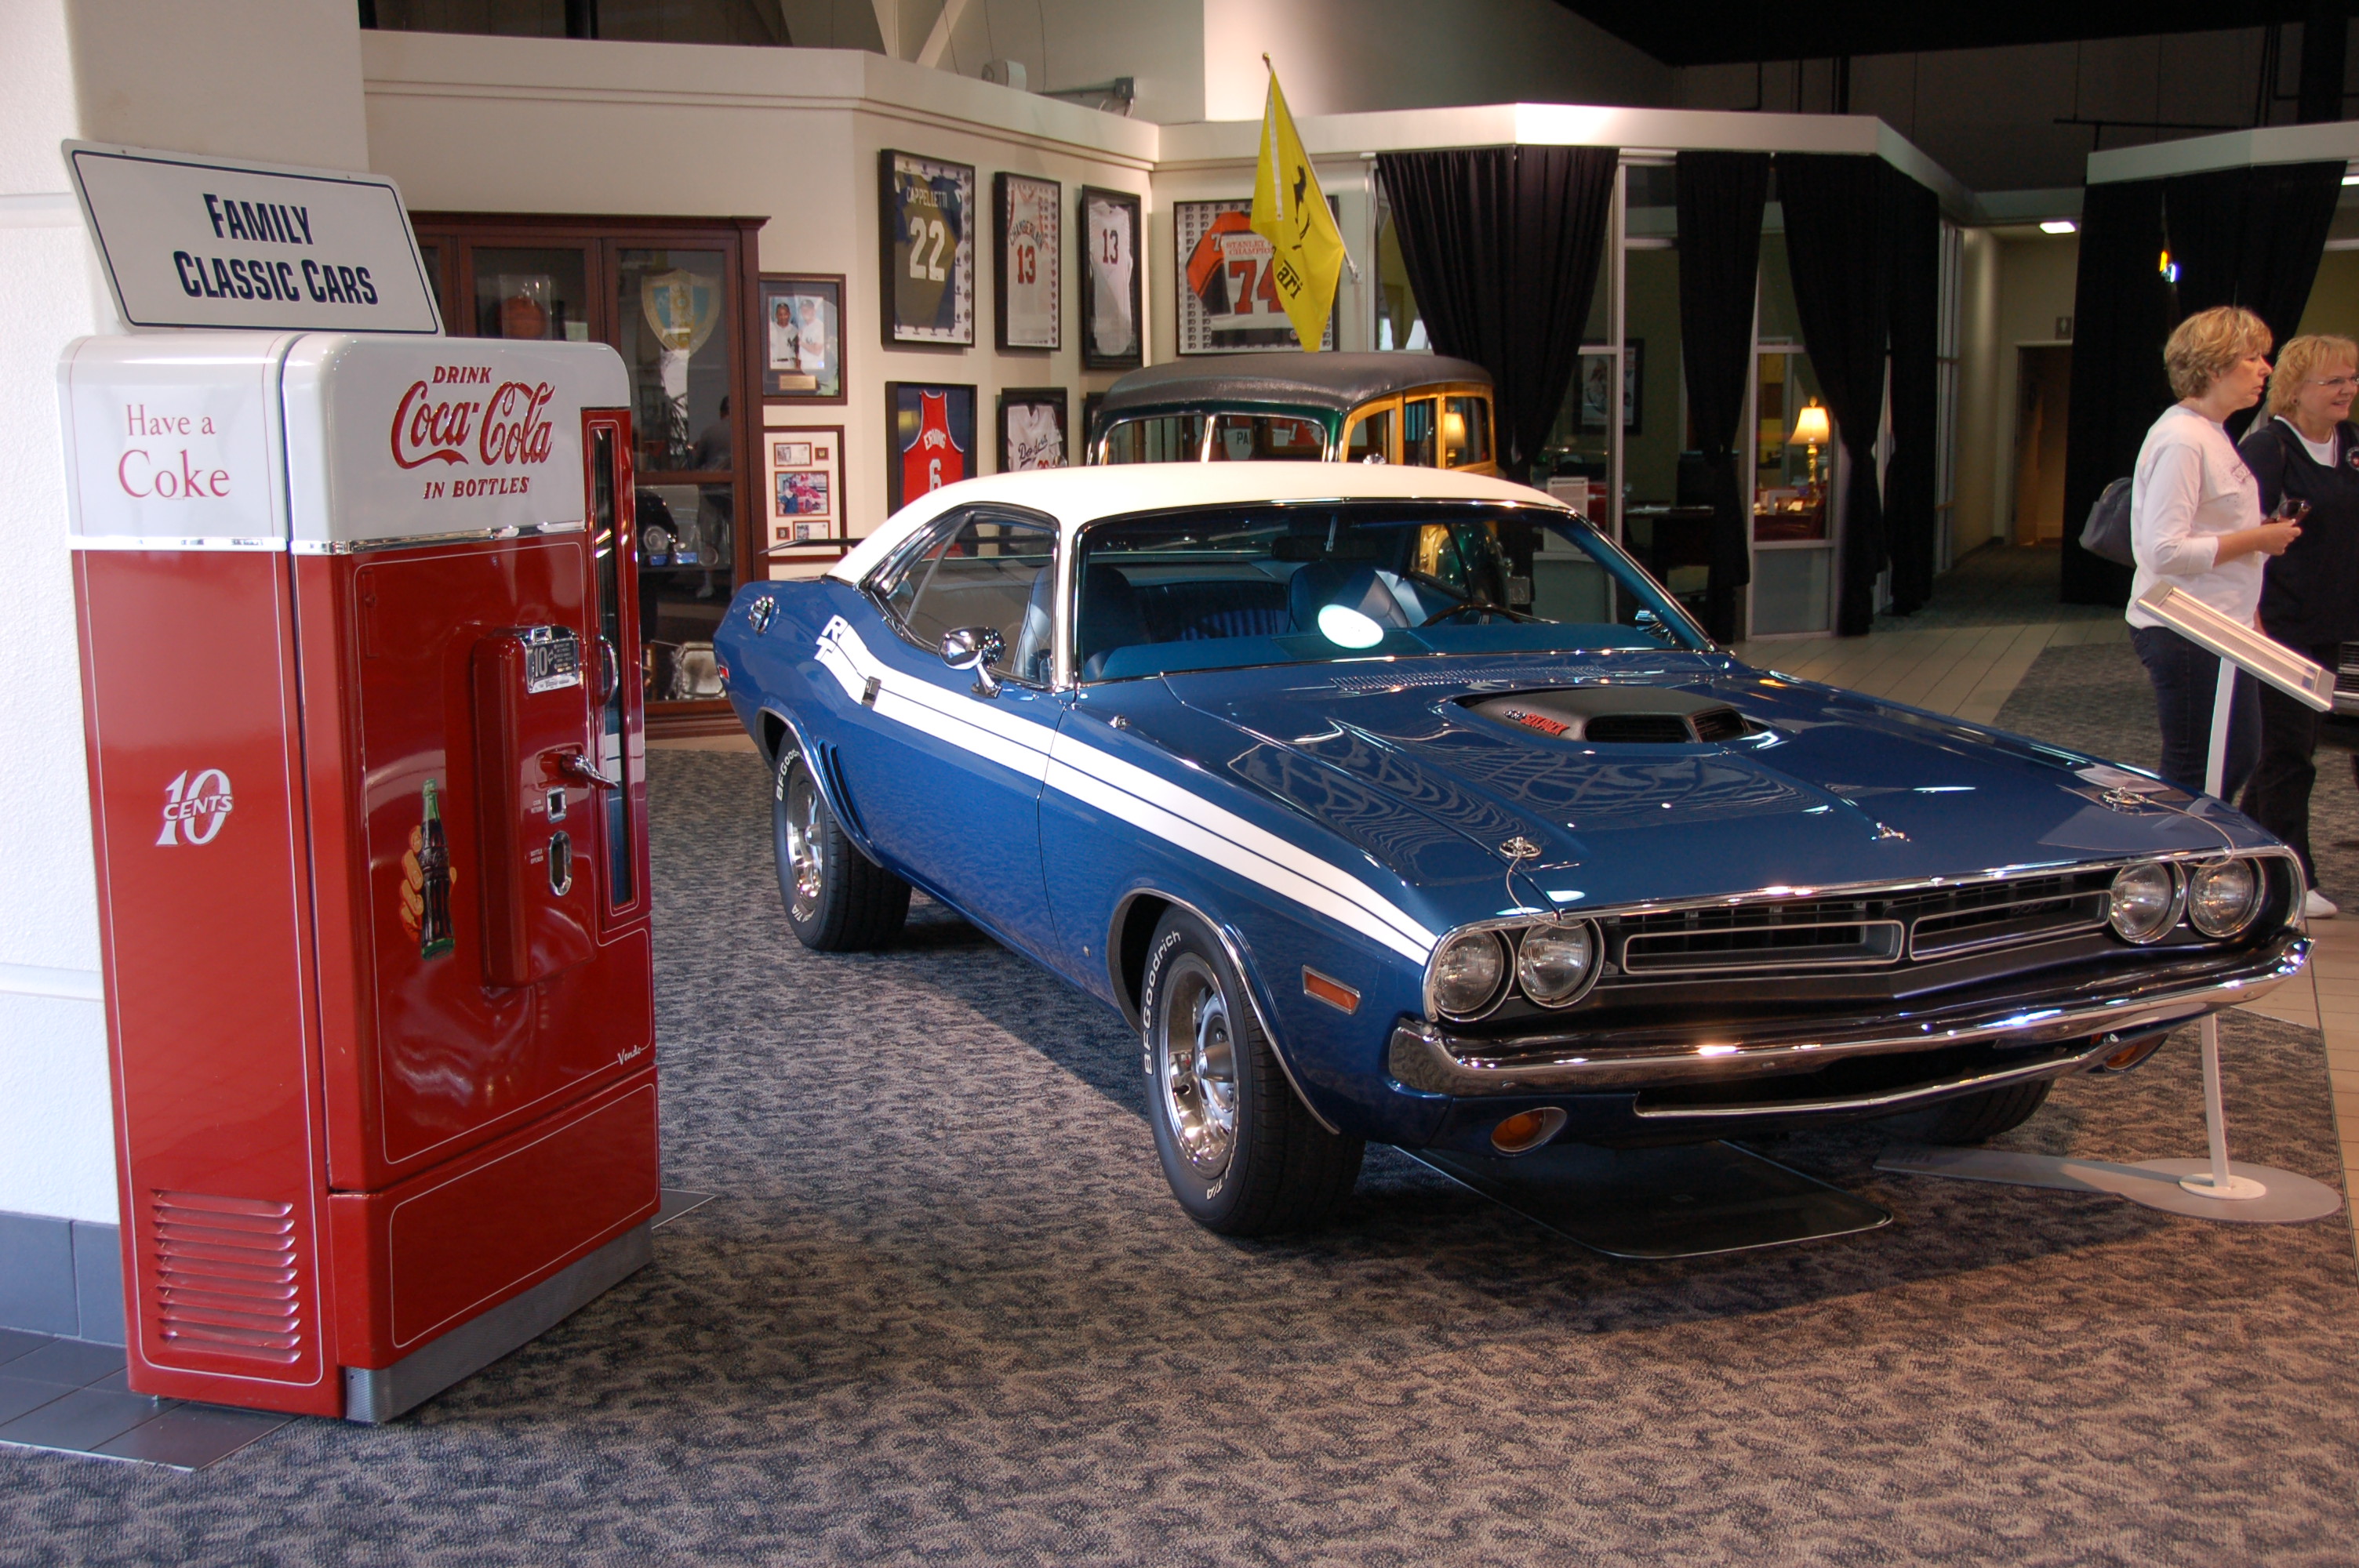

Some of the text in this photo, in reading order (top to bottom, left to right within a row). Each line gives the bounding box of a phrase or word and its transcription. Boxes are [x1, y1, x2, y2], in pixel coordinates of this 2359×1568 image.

[202, 193, 314, 245] FAMILY
[910, 216, 945, 281] 22
[1102, 228, 1119, 265] 13
[1226, 239, 1267, 249] STANLEY
[173, 251, 379, 305] CLASSIC CARS
[1017, 244, 1037, 285] 13
[1276, 260, 1304, 300] ari
[1228, 258, 1285, 315] 74
[432, 365, 493, 384] DRINK
[126, 404, 216, 436] Have a
[391, 380, 555, 470] Coca-Cola
[923, 428, 947, 452] ERVING
[118, 448, 231, 498] Coke
[423, 477, 530, 499] IN BOTTLES
[929, 458, 943, 492] 6
[156, 768, 232, 845] 10
[162, 795, 233, 821] CENTS
[1143, 931, 1182, 1075] BFGoodrich
[617, 1044, 642, 1065] Vendo
